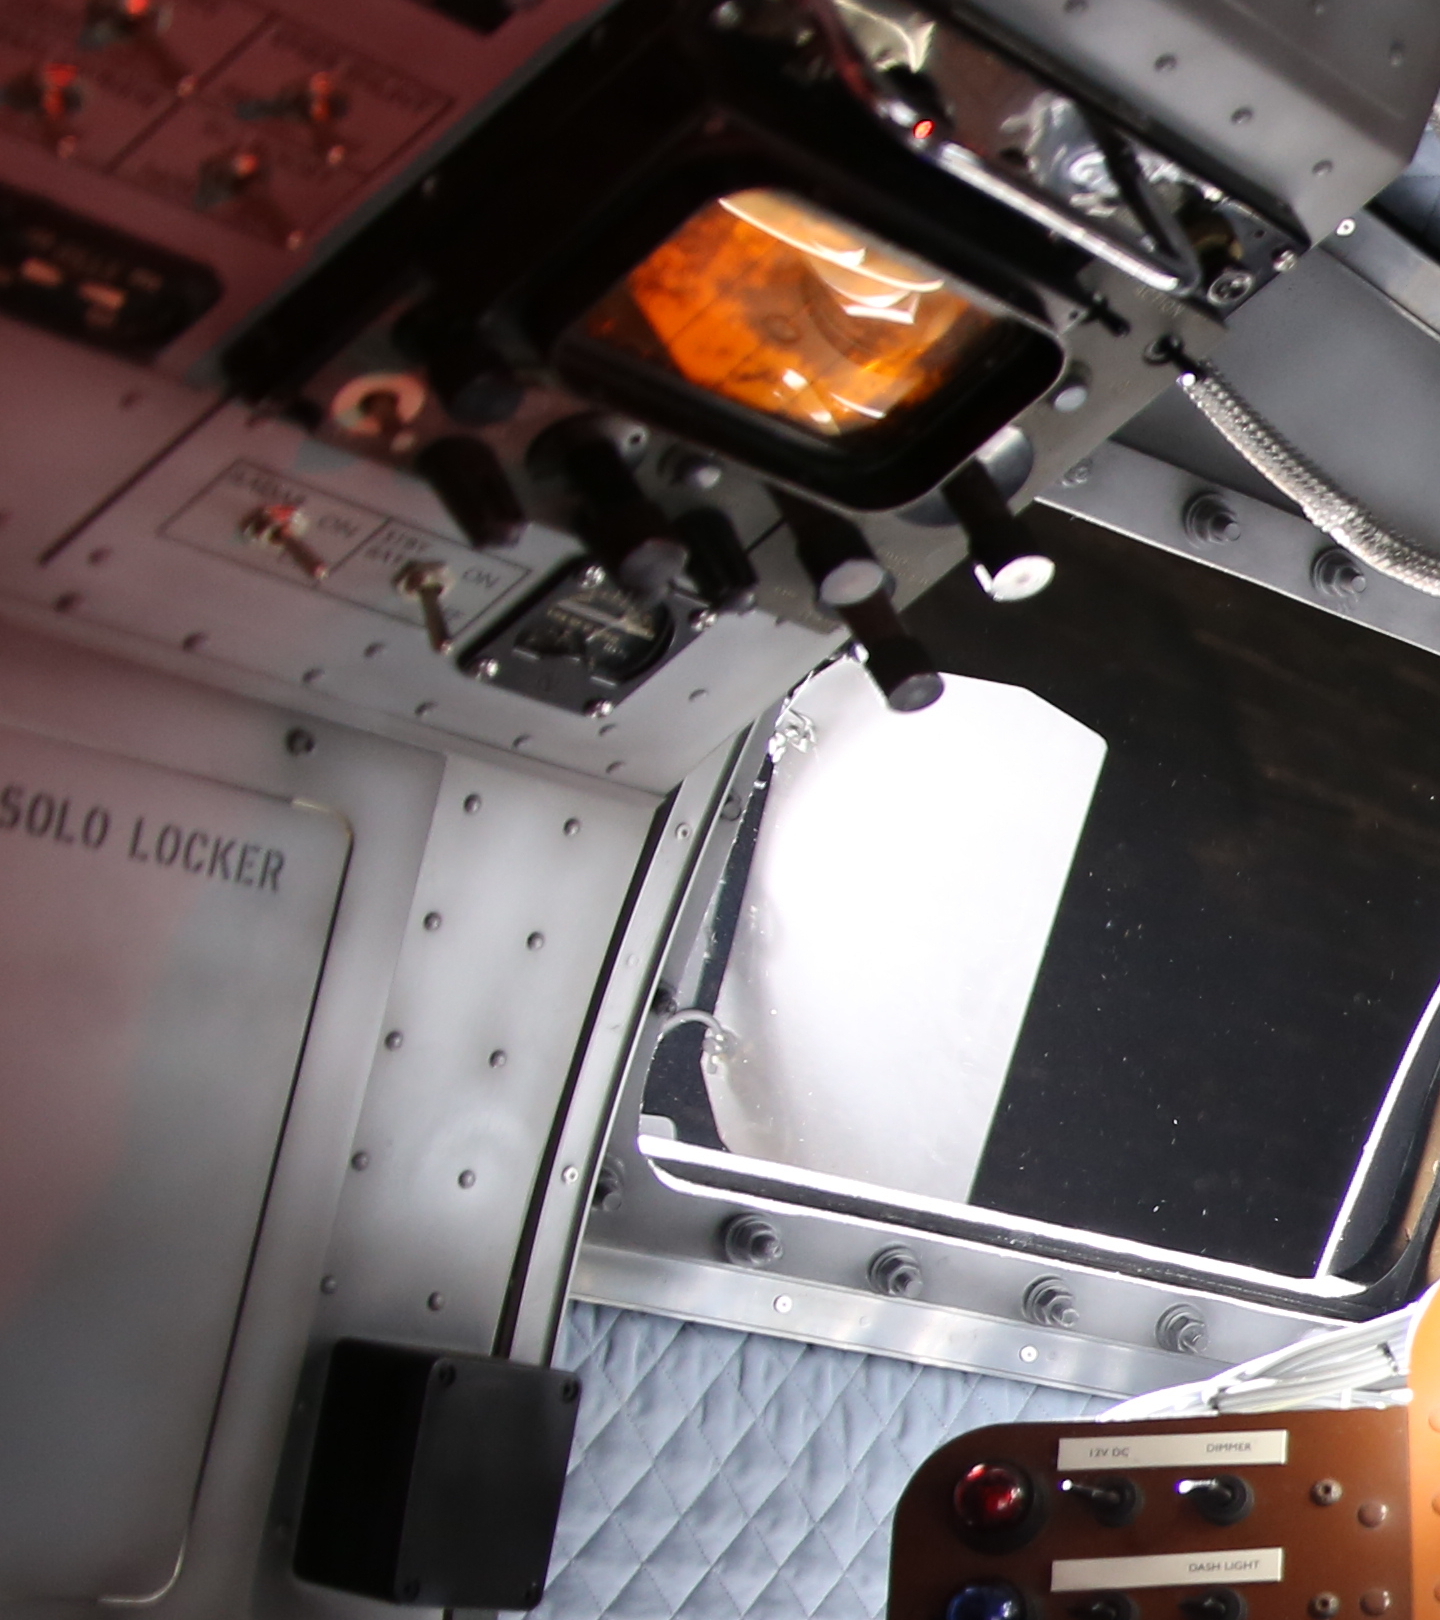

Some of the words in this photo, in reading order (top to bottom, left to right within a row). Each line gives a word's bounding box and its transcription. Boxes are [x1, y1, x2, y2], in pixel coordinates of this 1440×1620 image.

[129, 815, 287, 894] LOCKER
[1089, 1447, 1108, 1458] 12V
[1112, 1446, 1130, 1457] DC
[1206, 1442, 1252, 1453] DIMMER
[1188, 1561, 1221, 1573] DASH
[1224, 1559, 1260, 1571] LIGHT
